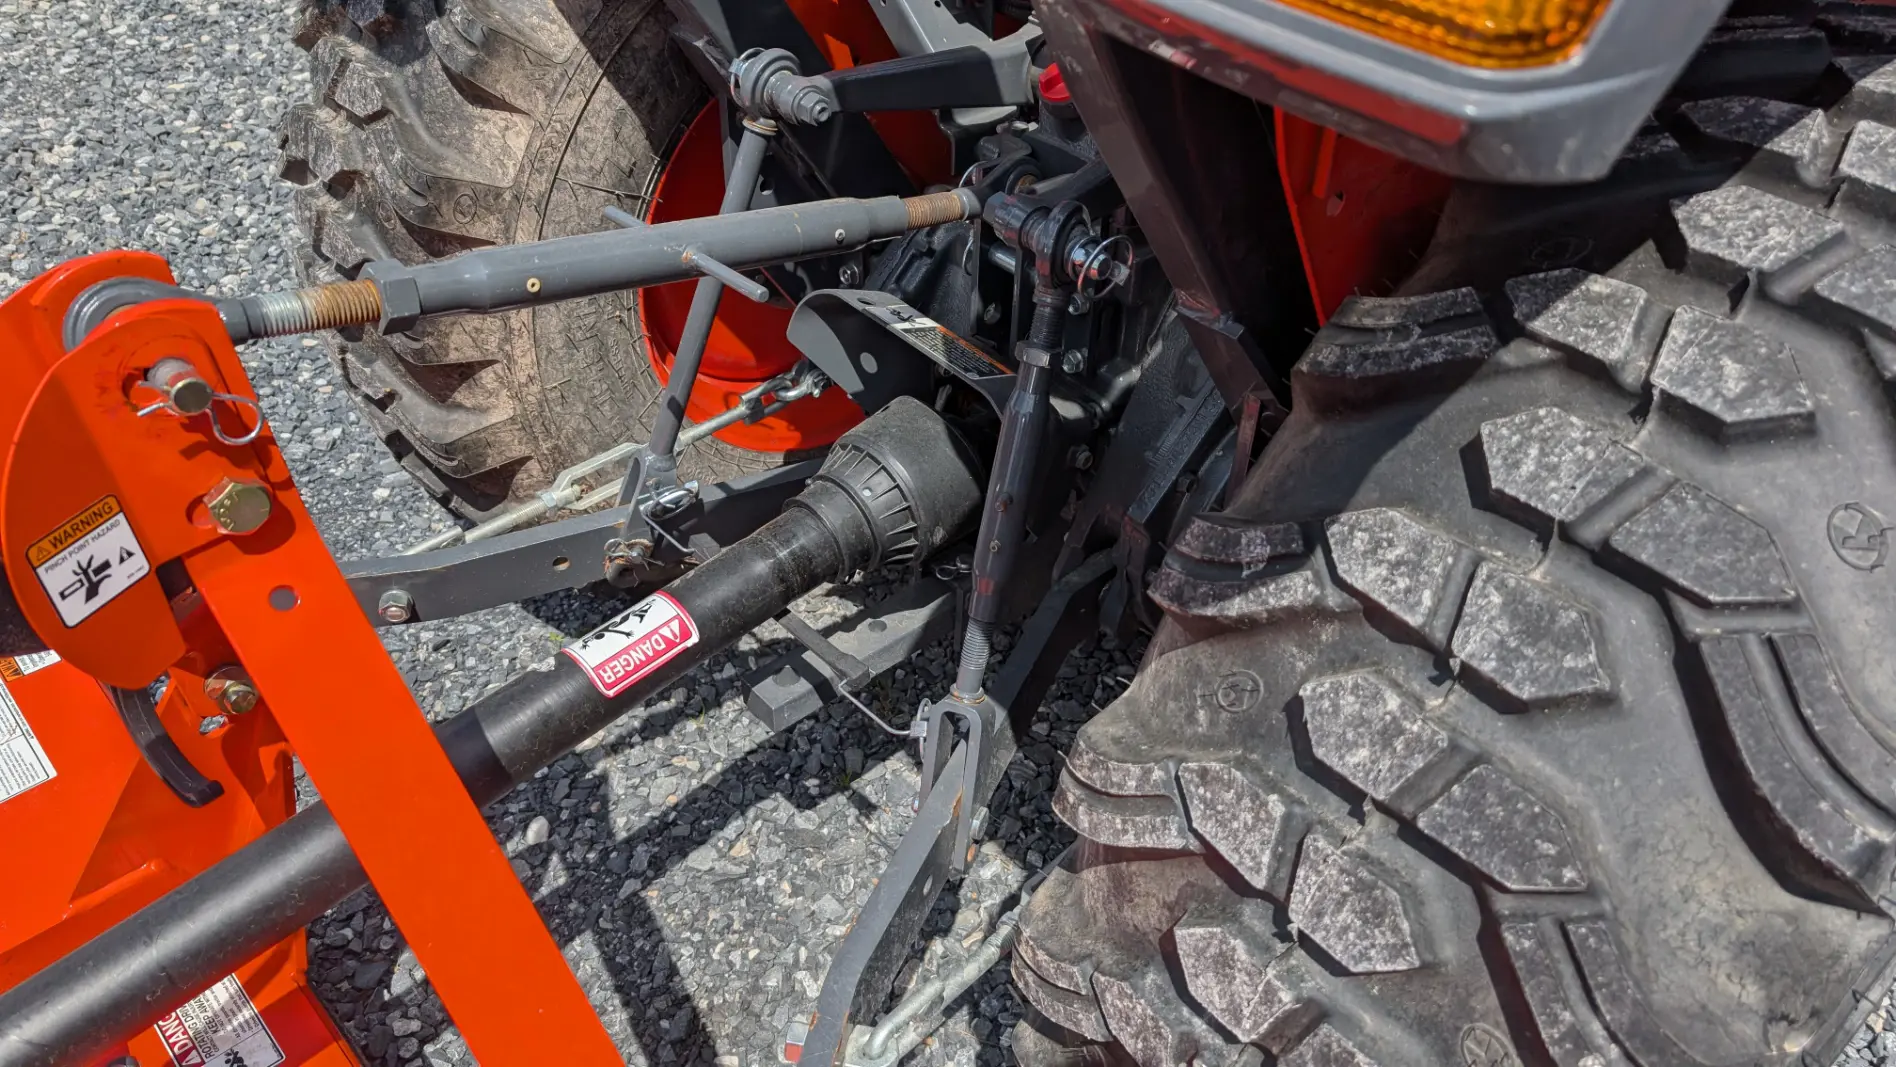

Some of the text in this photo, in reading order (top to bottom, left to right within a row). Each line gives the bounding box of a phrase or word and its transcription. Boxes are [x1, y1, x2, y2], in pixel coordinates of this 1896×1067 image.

[44, 518, 121, 574] PINCH POINT HAZARD
[47, 501, 113, 550] WARNING
[599, 633, 666, 684] DANGER
[158, 1011, 194, 1056] DANG
[186, 1020, 215, 1060] ROTATING
[201, 1011, 220, 1035] KEEP
